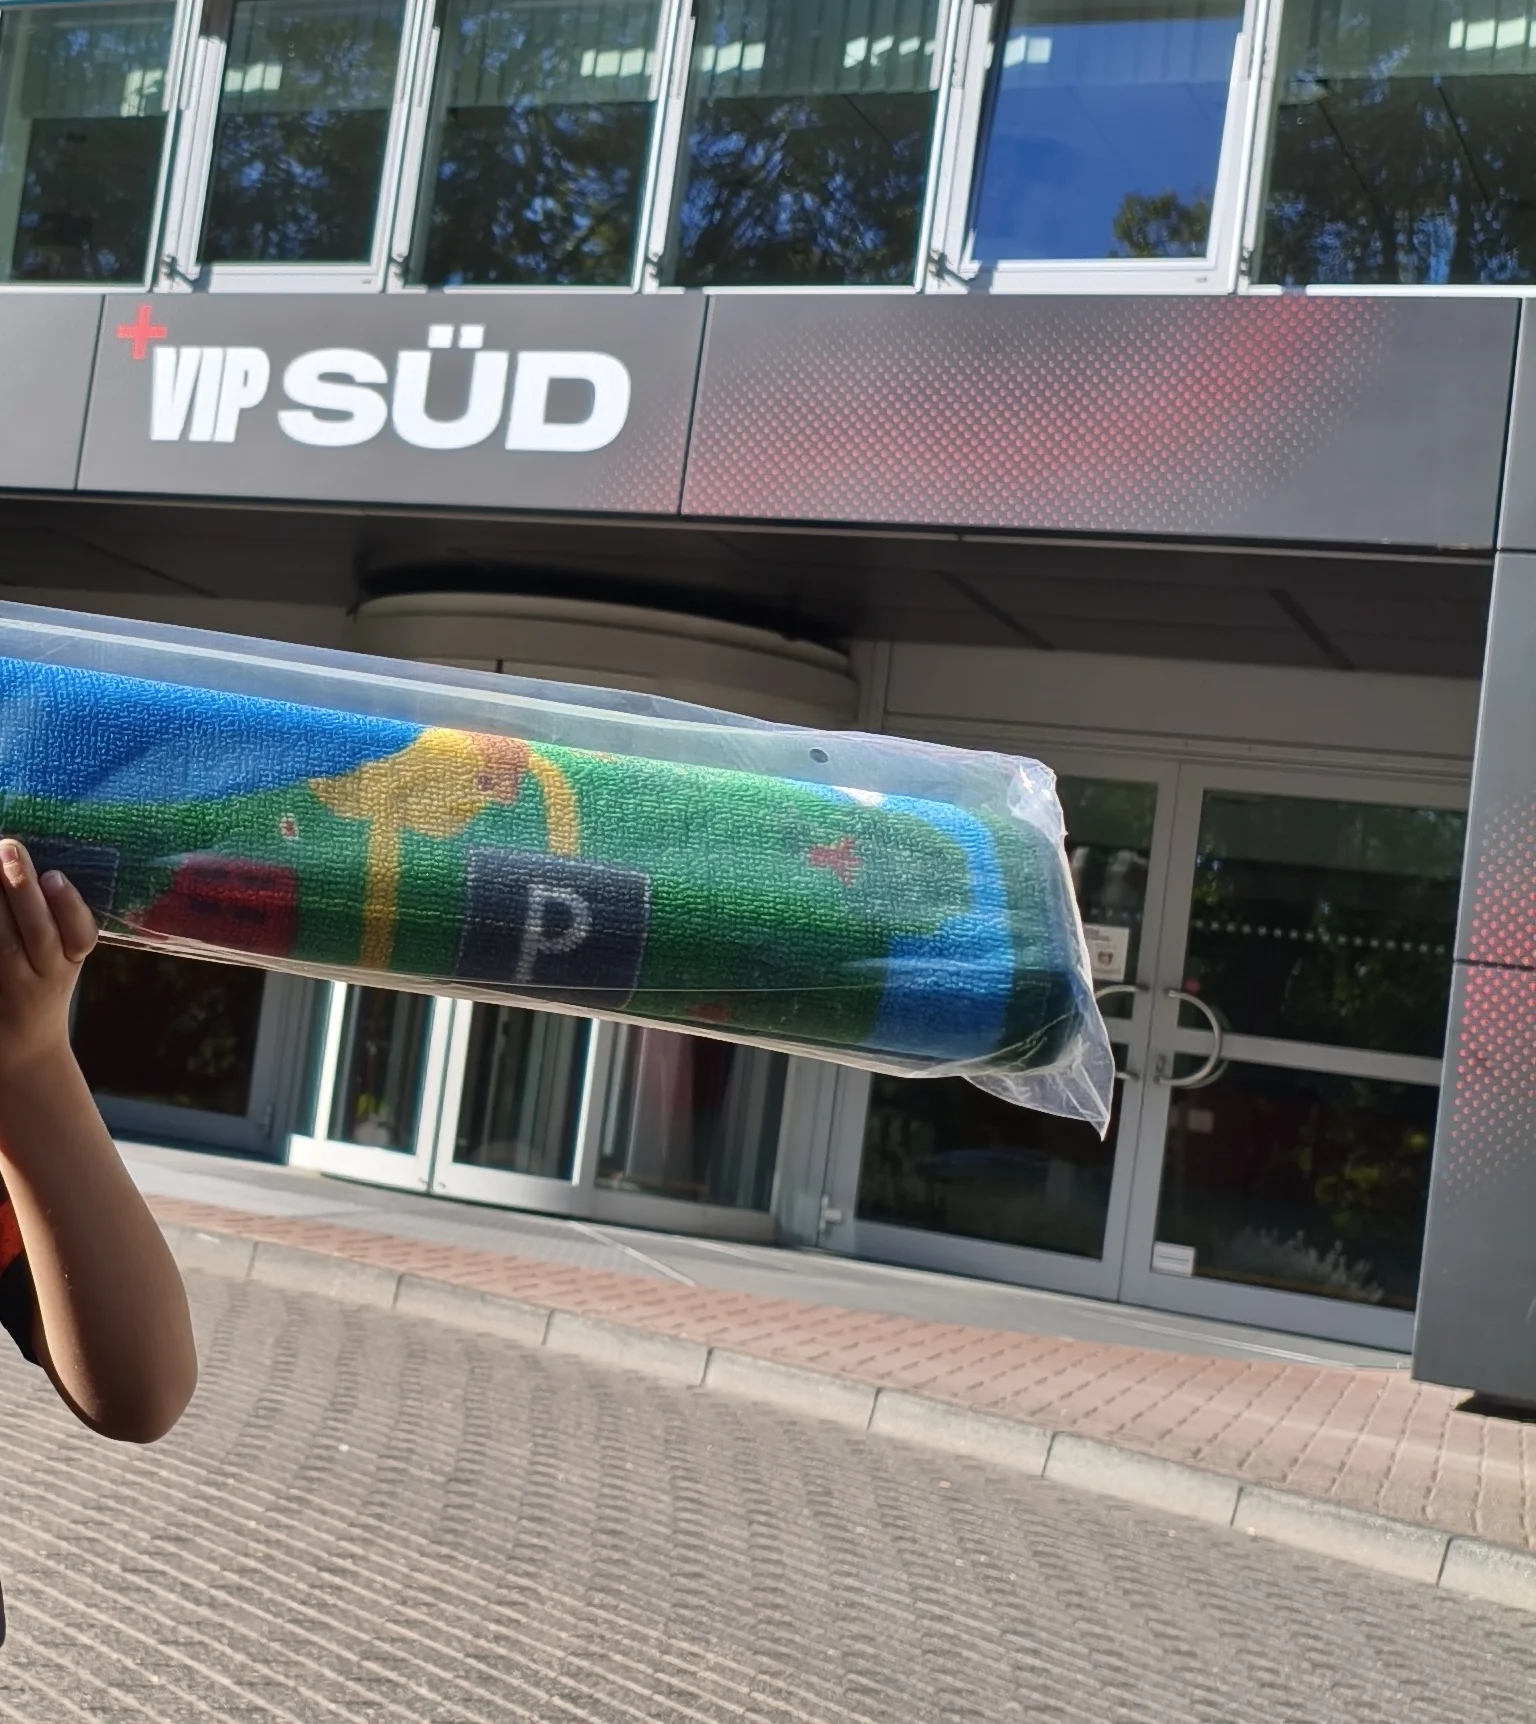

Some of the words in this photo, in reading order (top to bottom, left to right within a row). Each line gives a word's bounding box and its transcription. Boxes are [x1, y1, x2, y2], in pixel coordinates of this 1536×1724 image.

[151, 346, 270, 443] VIP
[278, 324, 631, 452] SÜD
[517, 883, 592, 983] P
